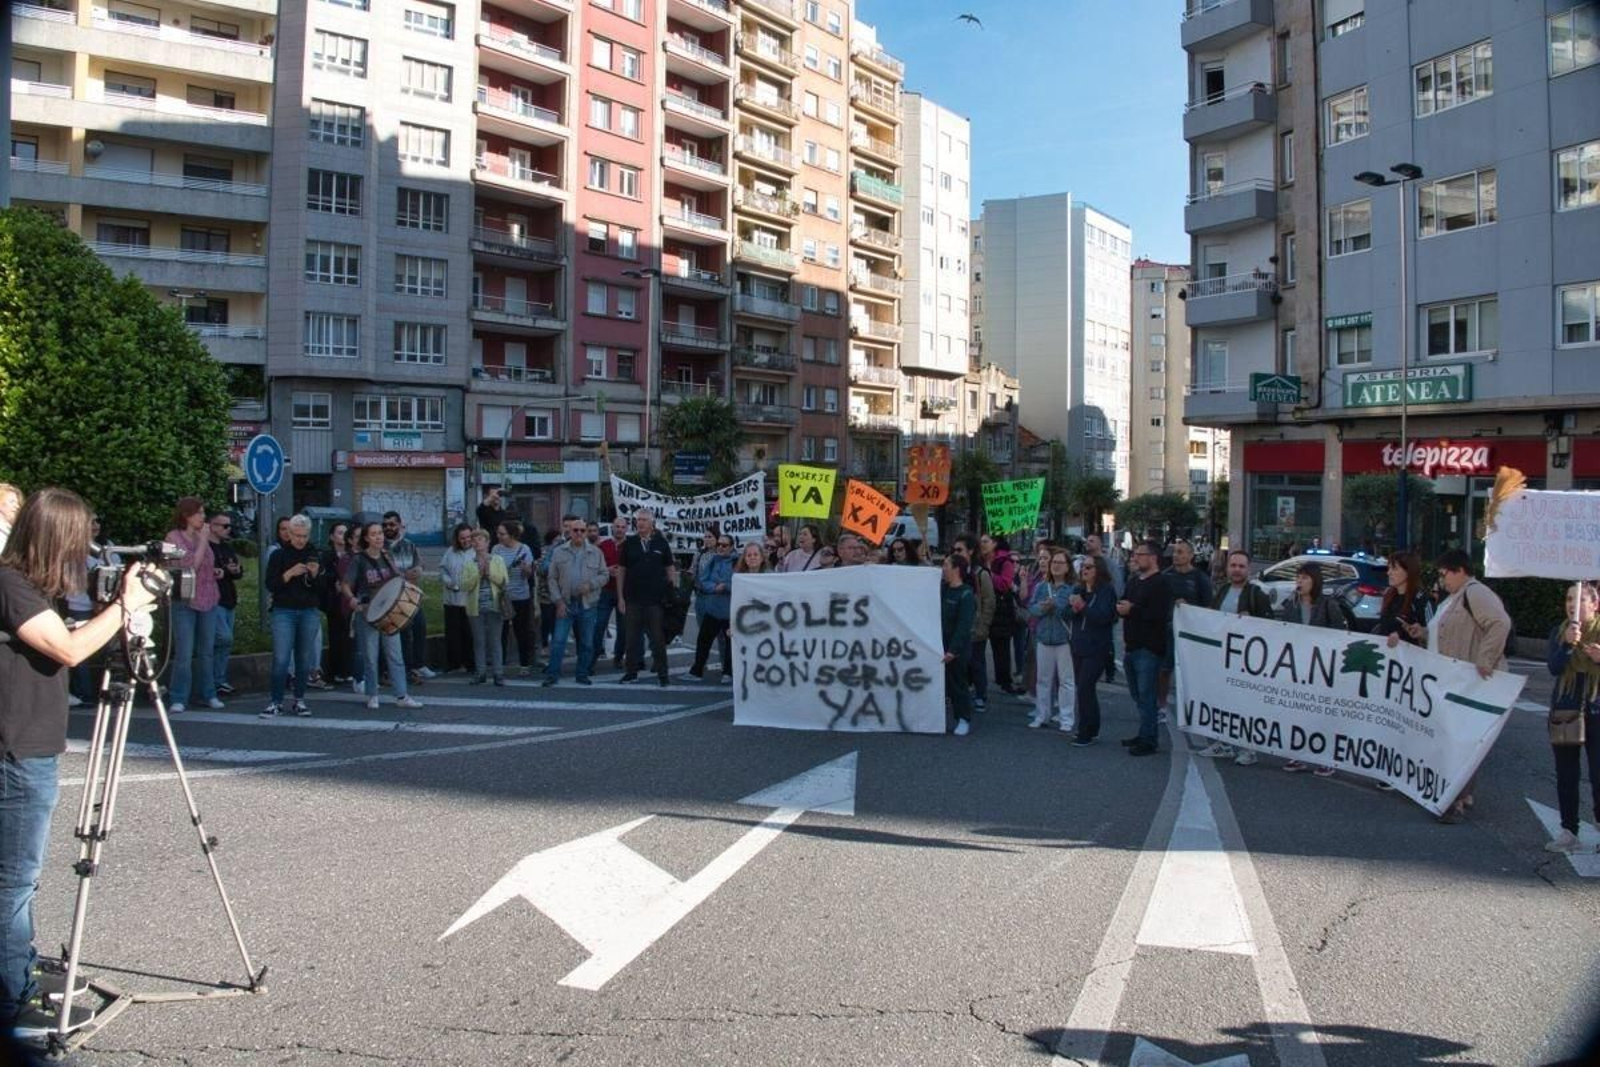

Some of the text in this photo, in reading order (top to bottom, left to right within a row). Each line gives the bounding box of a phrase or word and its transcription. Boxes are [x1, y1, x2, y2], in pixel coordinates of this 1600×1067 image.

[1356, 367, 1451, 381] ASESORIA
[1358, 381, 1450, 404] ATENEA
[1382, 442, 1489, 476] telepizza
[784, 470, 831, 483] CONSERJE
[789, 485, 824, 506] YA
[919, 485, 940, 499] XA
[677, 501, 745, 520] CARBALLAL
[847, 502, 879, 534] XA
[723, 515, 762, 533] CABRAL
[735, 592, 869, 635] COLES
[1263, 695, 1277, 705] DE
[1278, 698, 1323, 714] ALUMNOS
[1325, 707, 1339, 717] DE
[1340, 709, 1366, 721] VIGO
[1318, 695, 1331, 705] DE
[1199, 701, 1283, 749] DEFENSA
[1290, 725, 1327, 754] DO
[1333, 734, 1403, 778] ENSINO
